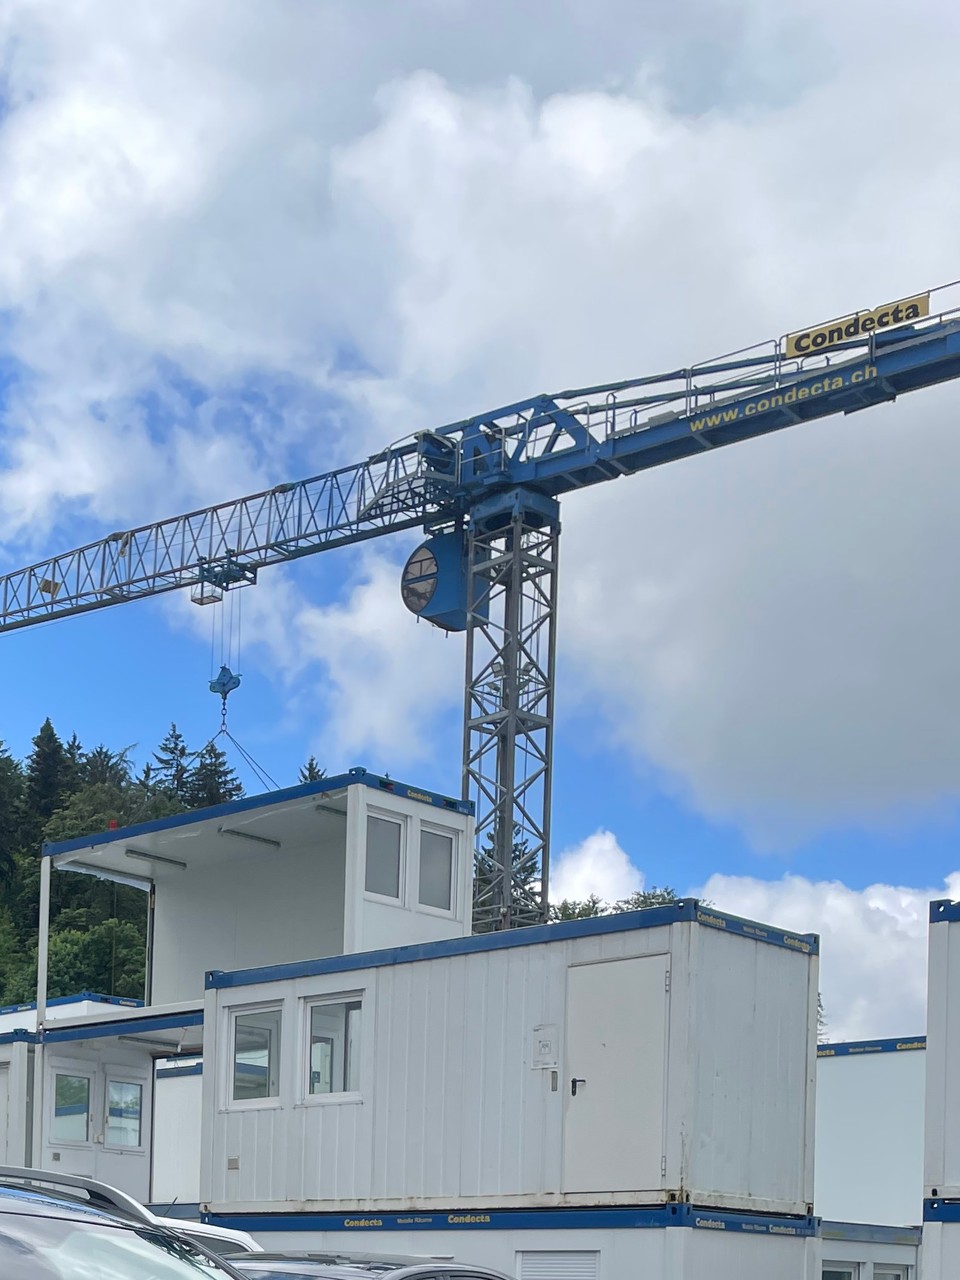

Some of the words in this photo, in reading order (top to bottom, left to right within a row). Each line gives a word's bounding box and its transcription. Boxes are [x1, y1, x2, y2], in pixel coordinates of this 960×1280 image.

[793, 301, 920, 353] Condecta
[689, 363, 878, 432] www.condecta.ch
[343, 1218, 383, 1228] Condecta
[447, 1214, 491, 1224] Condecta
